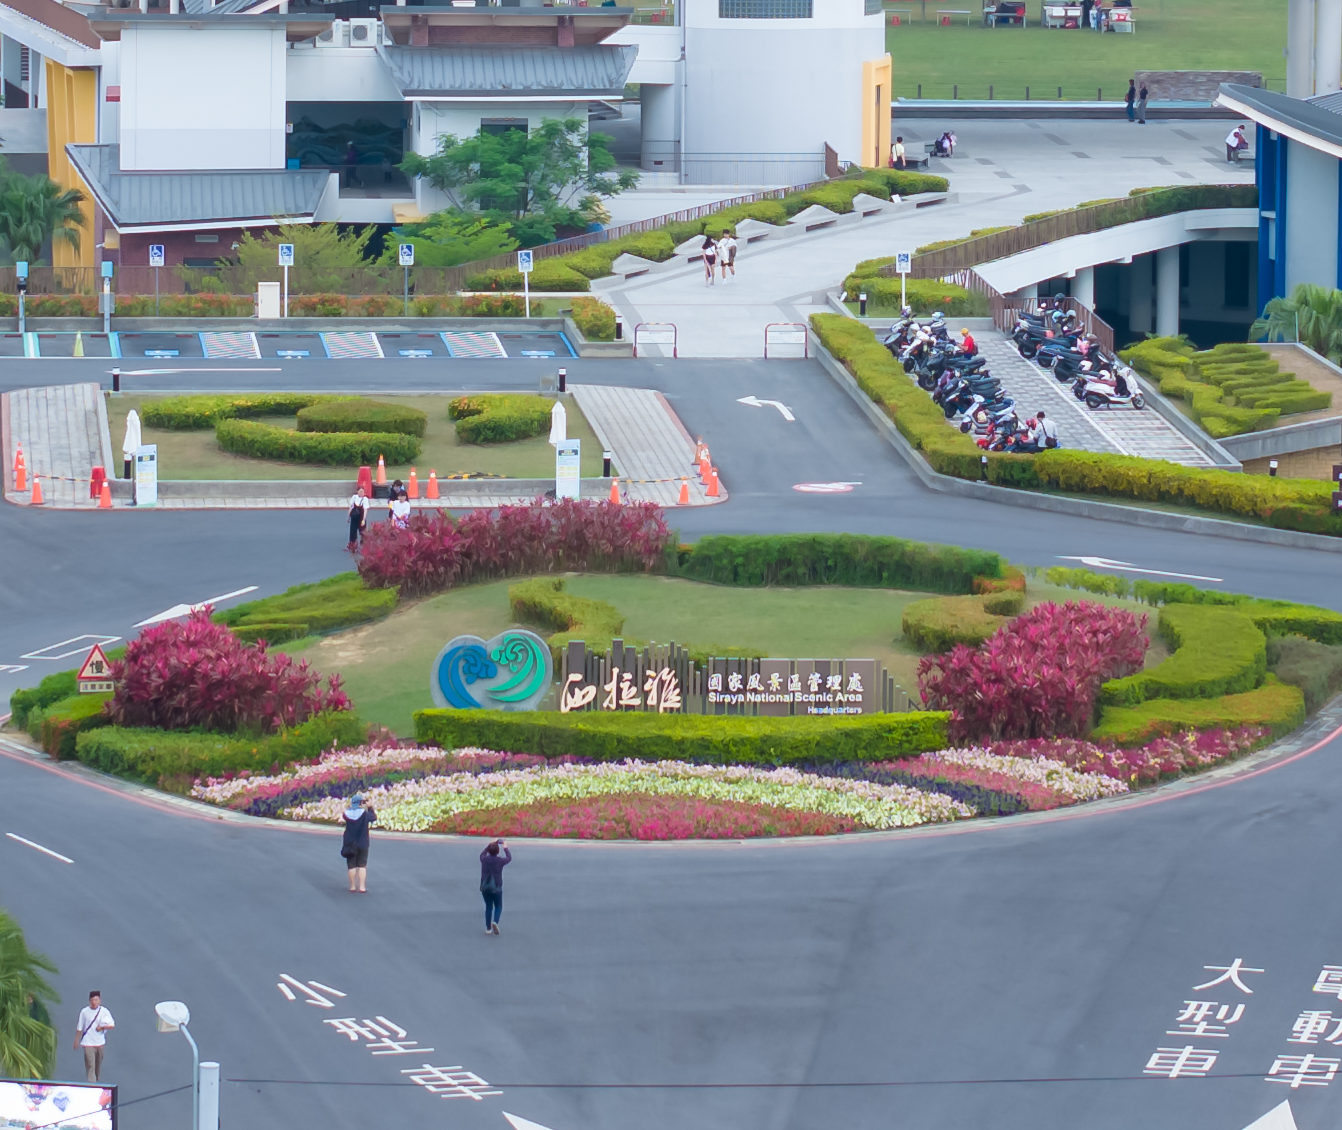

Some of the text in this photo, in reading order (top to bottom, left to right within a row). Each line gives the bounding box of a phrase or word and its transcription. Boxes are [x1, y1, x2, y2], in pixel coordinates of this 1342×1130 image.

[89, 660, 104, 674] 慢
[561, 667, 682, 714] 西拉雅
[709, 692, 863, 705] Siraya National Scenic Area
[807, 706, 863, 716] Headquarters
[1142, 957, 1265, 1078] 大型車
[276, 973, 504, 1101] 小型車
